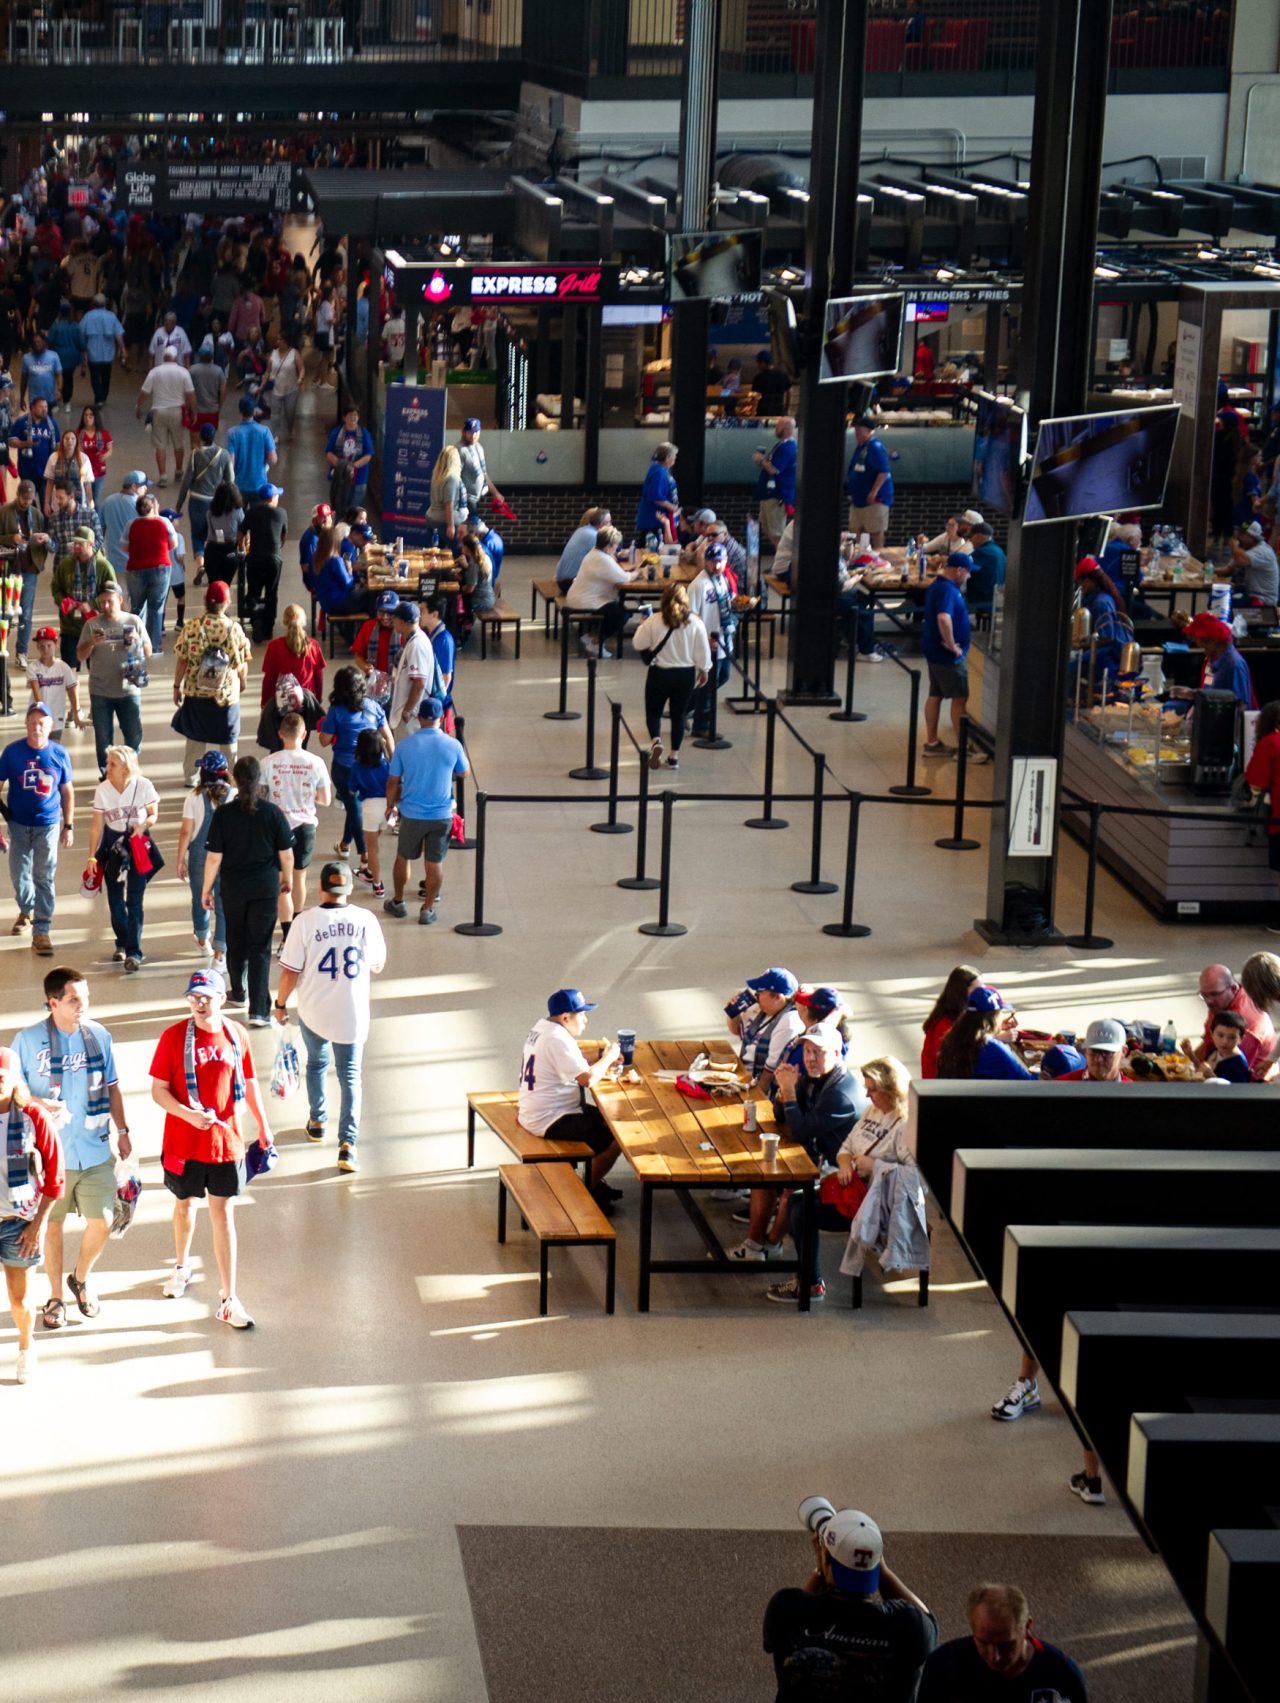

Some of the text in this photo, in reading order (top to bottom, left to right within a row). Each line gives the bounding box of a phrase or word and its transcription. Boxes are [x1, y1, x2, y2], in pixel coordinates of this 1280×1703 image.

[125, 171, 156, 185] Globe
[130, 184, 151, 195] Life
[471, 272, 602, 298] EXPRESS Grill
[920, 290, 970, 301] TENDERS
[978, 290, 1010, 301] FRIES
[317, 946, 363, 980] 48
[194, 1045, 235, 1067] EXA
[520, 1054, 536, 1090] 4
[854, 1549, 872, 1567] T
